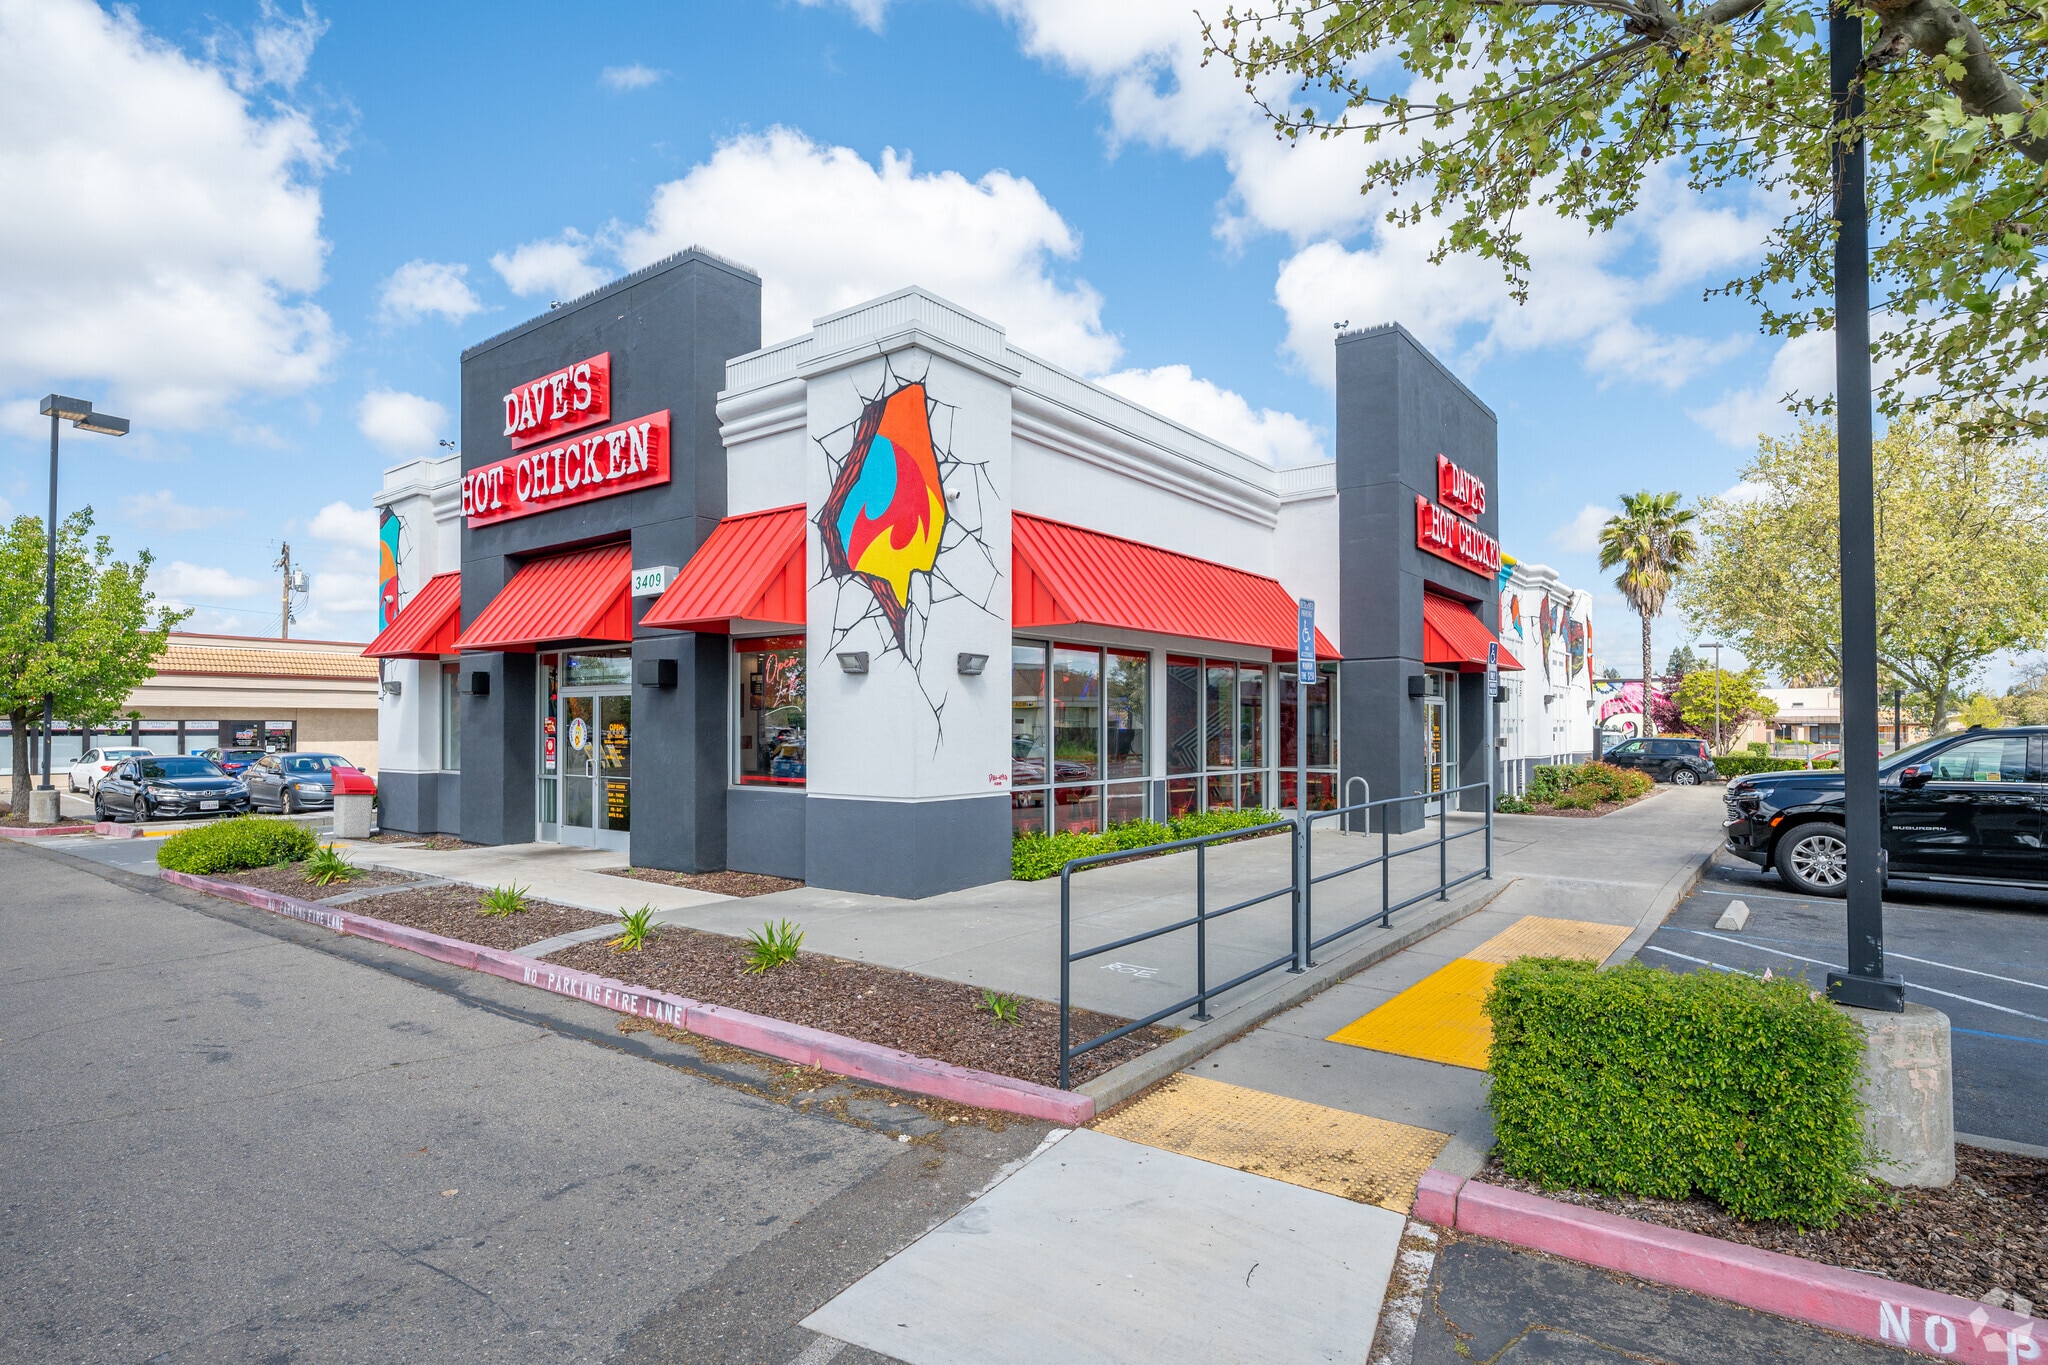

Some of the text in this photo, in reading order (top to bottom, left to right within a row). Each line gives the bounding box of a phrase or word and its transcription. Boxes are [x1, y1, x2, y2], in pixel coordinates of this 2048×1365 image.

[503, 363, 592, 436] DAVE'S
[460, 423, 651, 517] HOT CHICKEN
[1451, 462, 1486, 514] DAVE'S
[1431, 504, 1502, 571] HOT CHICKEN
[635, 572, 662, 590] 3409
[766, 653, 799, 683] Open
[267, 897, 345, 931] NO PARKING FIRE LANE
[523, 966, 683, 1026] NO PARKING FIRE LANE
[1879, 1300, 1957, 1355] NO
